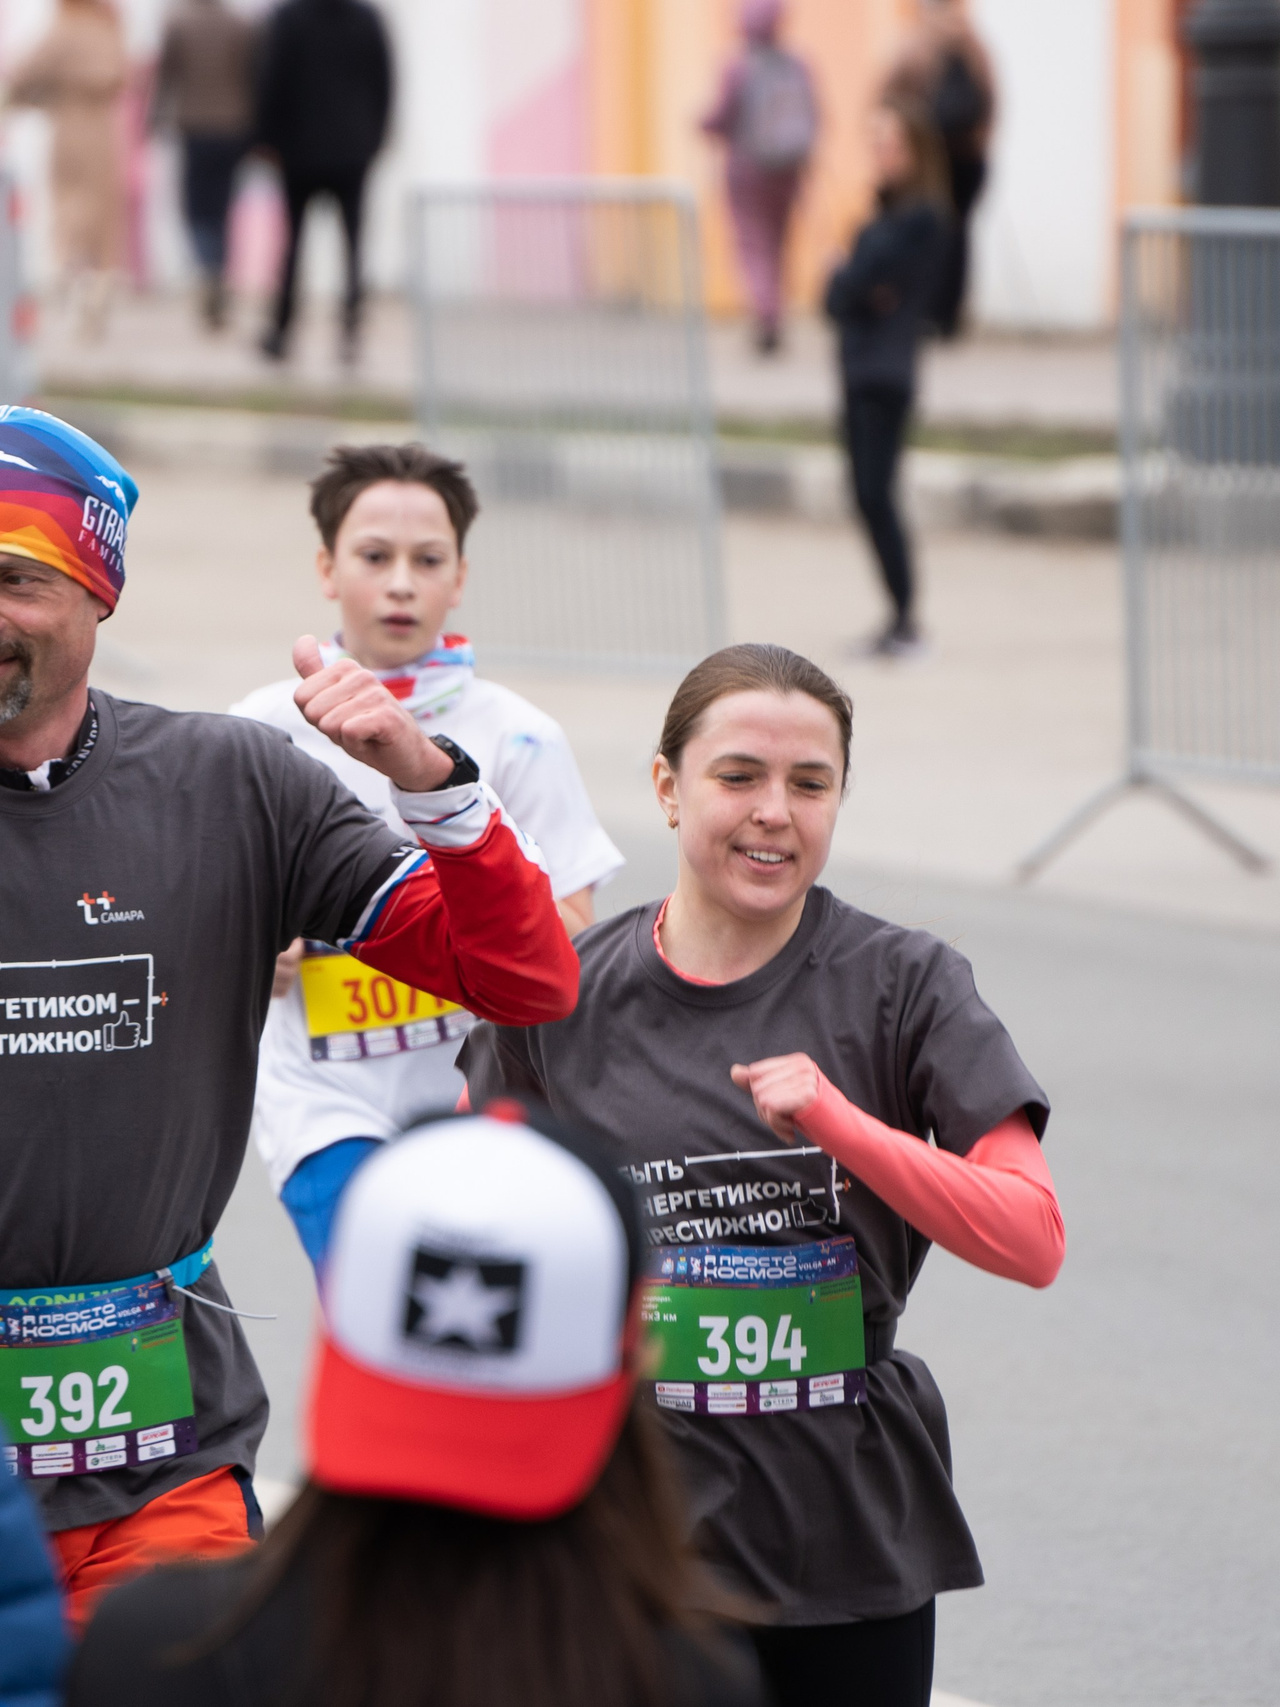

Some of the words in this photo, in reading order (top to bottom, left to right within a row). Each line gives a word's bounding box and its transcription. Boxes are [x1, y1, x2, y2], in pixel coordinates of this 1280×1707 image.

[82, 495, 127, 556] GTRA
[101, 909, 145, 923] САМАРА
[719, 1255, 797, 1267] ПРОСТО
[704, 1266, 797, 1280] КОСМОС
[23, 1315, 35, 1325] Я
[39, 1303, 116, 1324] ПРОСТО
[23, 1315, 117, 1338] КОСМОС
[697, 1314, 807, 1376] 394
[21, 1365, 132, 1437] 392
